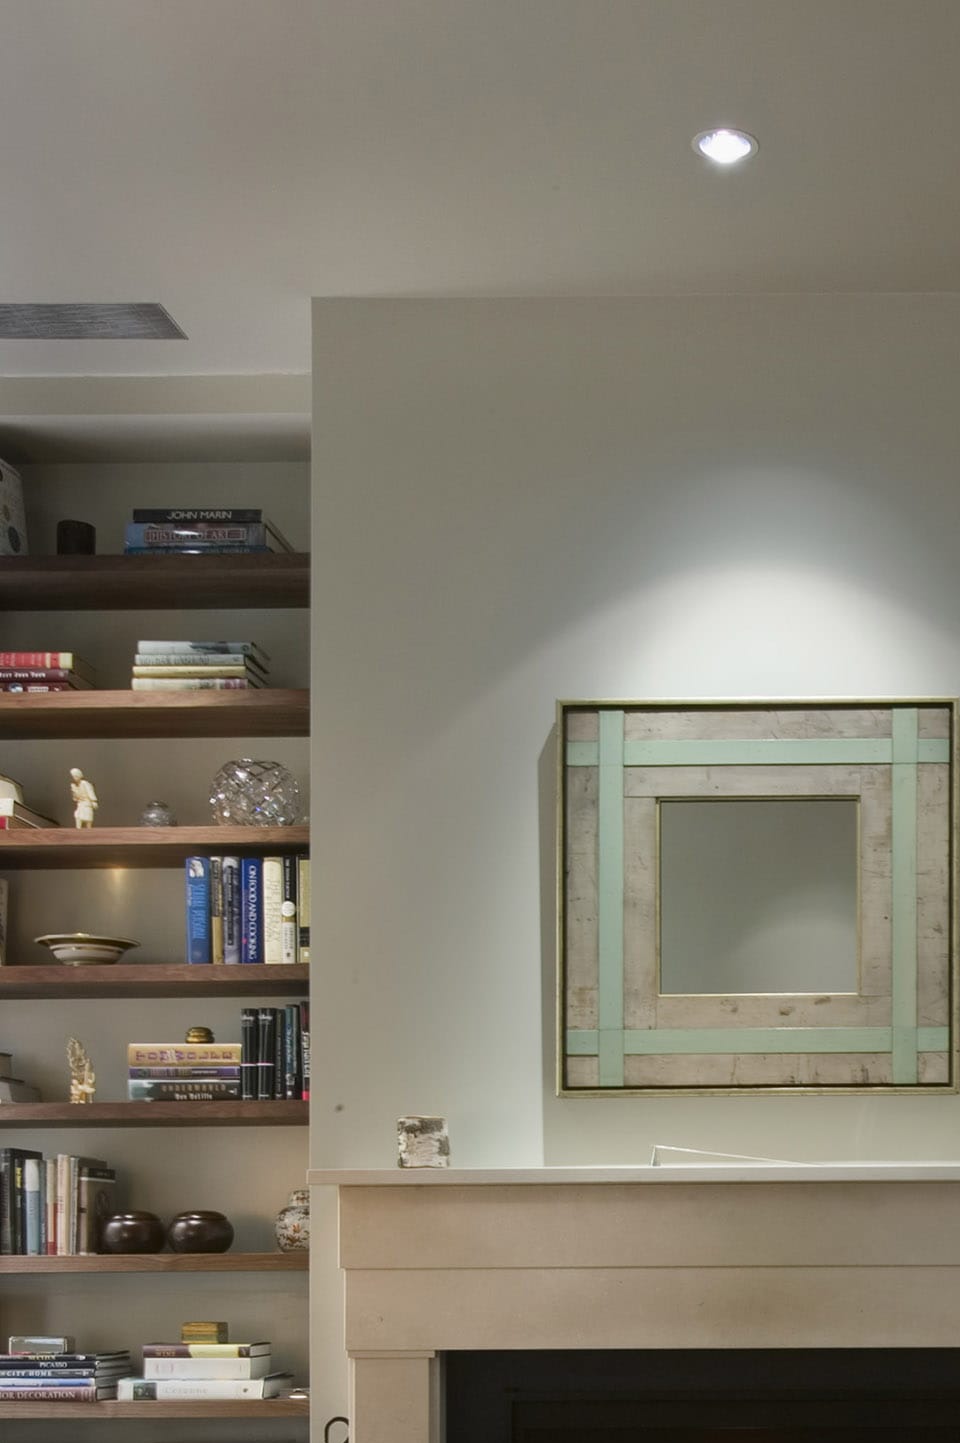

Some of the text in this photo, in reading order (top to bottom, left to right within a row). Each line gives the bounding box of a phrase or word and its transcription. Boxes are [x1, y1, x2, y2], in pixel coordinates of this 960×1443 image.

[167, 511, 232, 519] JOHN MARIN
[248, 879, 258, 902] FOOD
[248, 902, 258, 921] AND
[248, 922, 258, 960] COOKING
[39, 1361, 68, 1369] PICASSO
[17, 1391, 76, 1399] DECORATION
